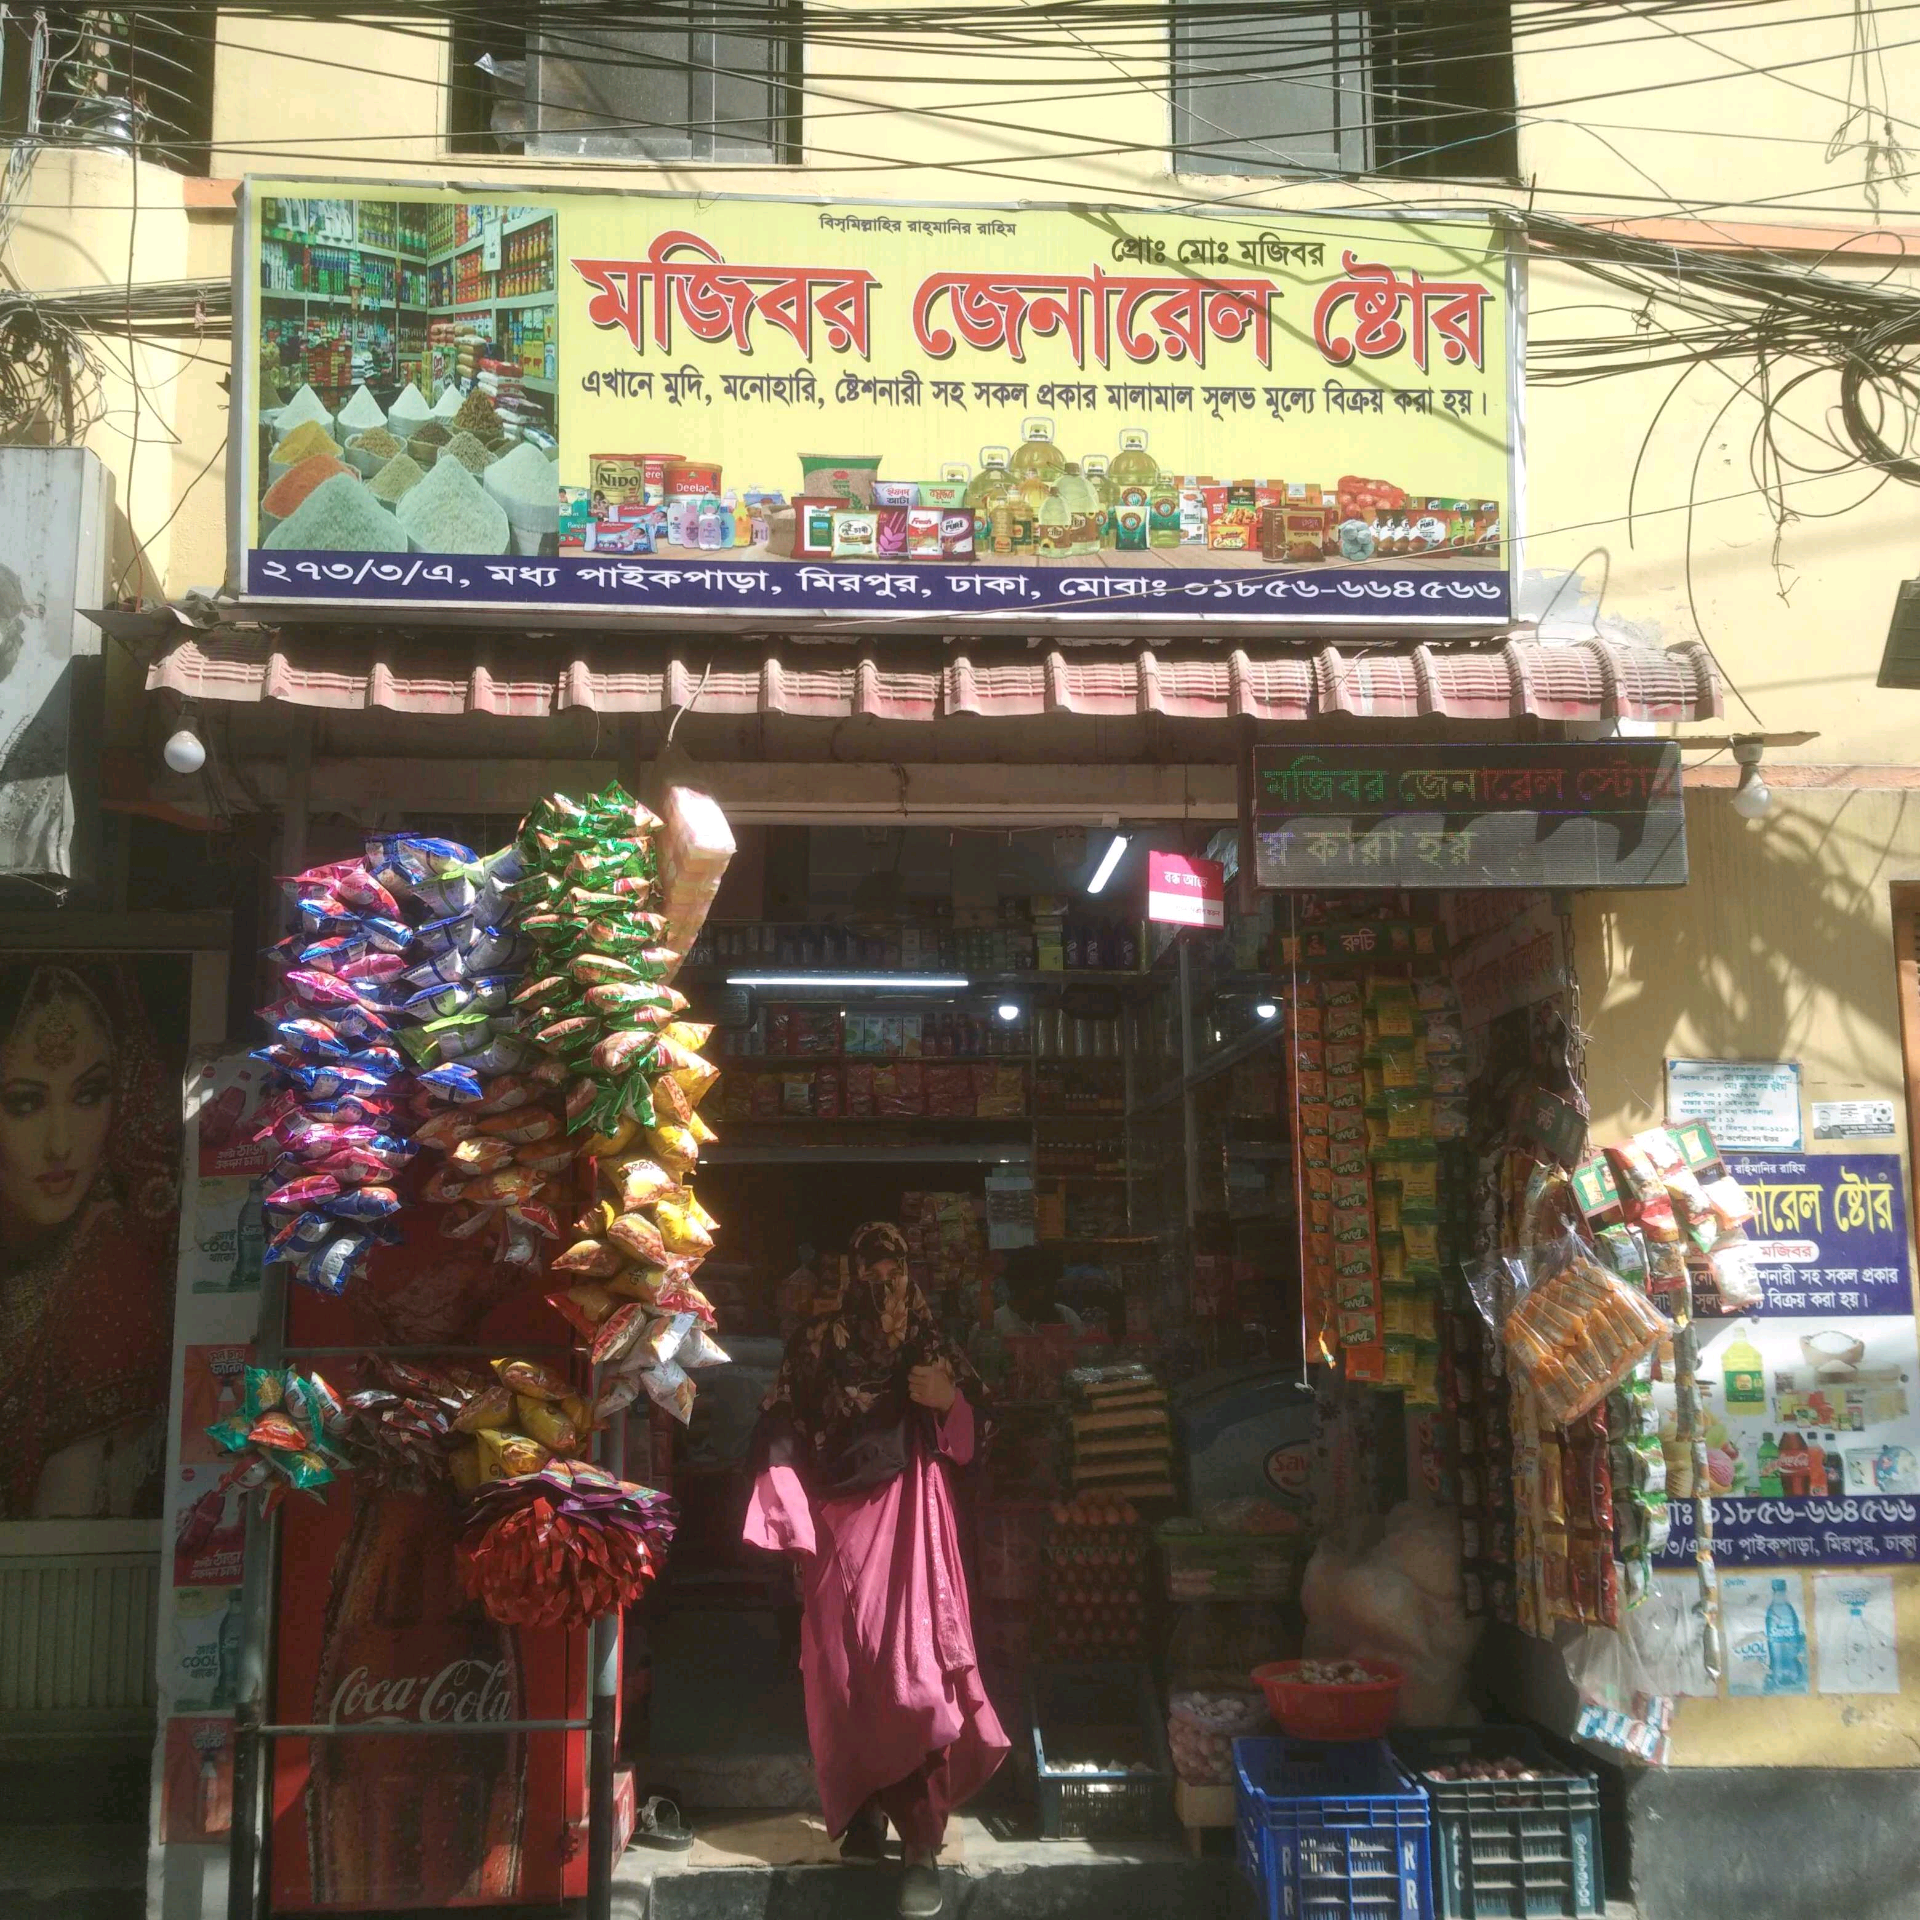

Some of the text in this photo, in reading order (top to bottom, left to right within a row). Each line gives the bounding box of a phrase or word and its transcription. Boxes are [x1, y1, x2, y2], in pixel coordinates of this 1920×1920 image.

[977, 219, 1016, 237] রাহিম
[1237, 231, 1327, 267] মজিবর
[570, 230, 1496, 374] মজিবর জেনারেল ষ্টোর
[581, 367, 654, 399] এখানে
[662, 364, 713, 408] মুদি,
[720, 363, 825, 410] মনোহারি,
[835, 369, 923, 408] ষ্টেশনারী
[932, 381, 969, 411] সহ
[974, 382, 1028, 411] সকল
[1037, 381, 1097, 412] প্রকার
[1106, 383, 1193, 414] মালামাল
[1265, 384, 1317, 422] মূল্যে
[1323, 378, 1384, 415] বিক্রয়
[1393, 384, 1433, 415] করা
[599, 474, 639, 487] NIDO
[676, 483, 710, 493] Deelac
[911, 517, 932, 525] Fresh
[261, 558, 1501, 600] ২৭৩/৩/এ, মধ্য পাইকপাড়া, মিরপুর, ঢাকা, মোবাঃ ০১৮৫৬-৬৬৪৫৬৬
[1261, 753, 1391, 803] মজিবর
[1398, 763, 1568, 803] জেনারেল
[1340, 928, 1378, 952] রুচি
[1779, 1160, 1806, 1175] রাহিম
[1833, 1165, 1895, 1235] ষ্টোর
[201, 1240, 237, 1252] COOL
[1759, 1242, 1814, 1260] মজিবর
[1799, 1267, 1824, 1287] সহ
[1825, 1267, 1860, 1287] সকল
[1862, 1267, 1900, 1287] প্রকার
[1768, 1288, 1806, 1310] বিক্রয়
[1810, 1291, 1836, 1309] করা
[1824, 1532, 1880, 1557] মিরপুর,
[182, 1656, 218, 1668] COOL
[329, 1659, 512, 1725] Coca-Cola
